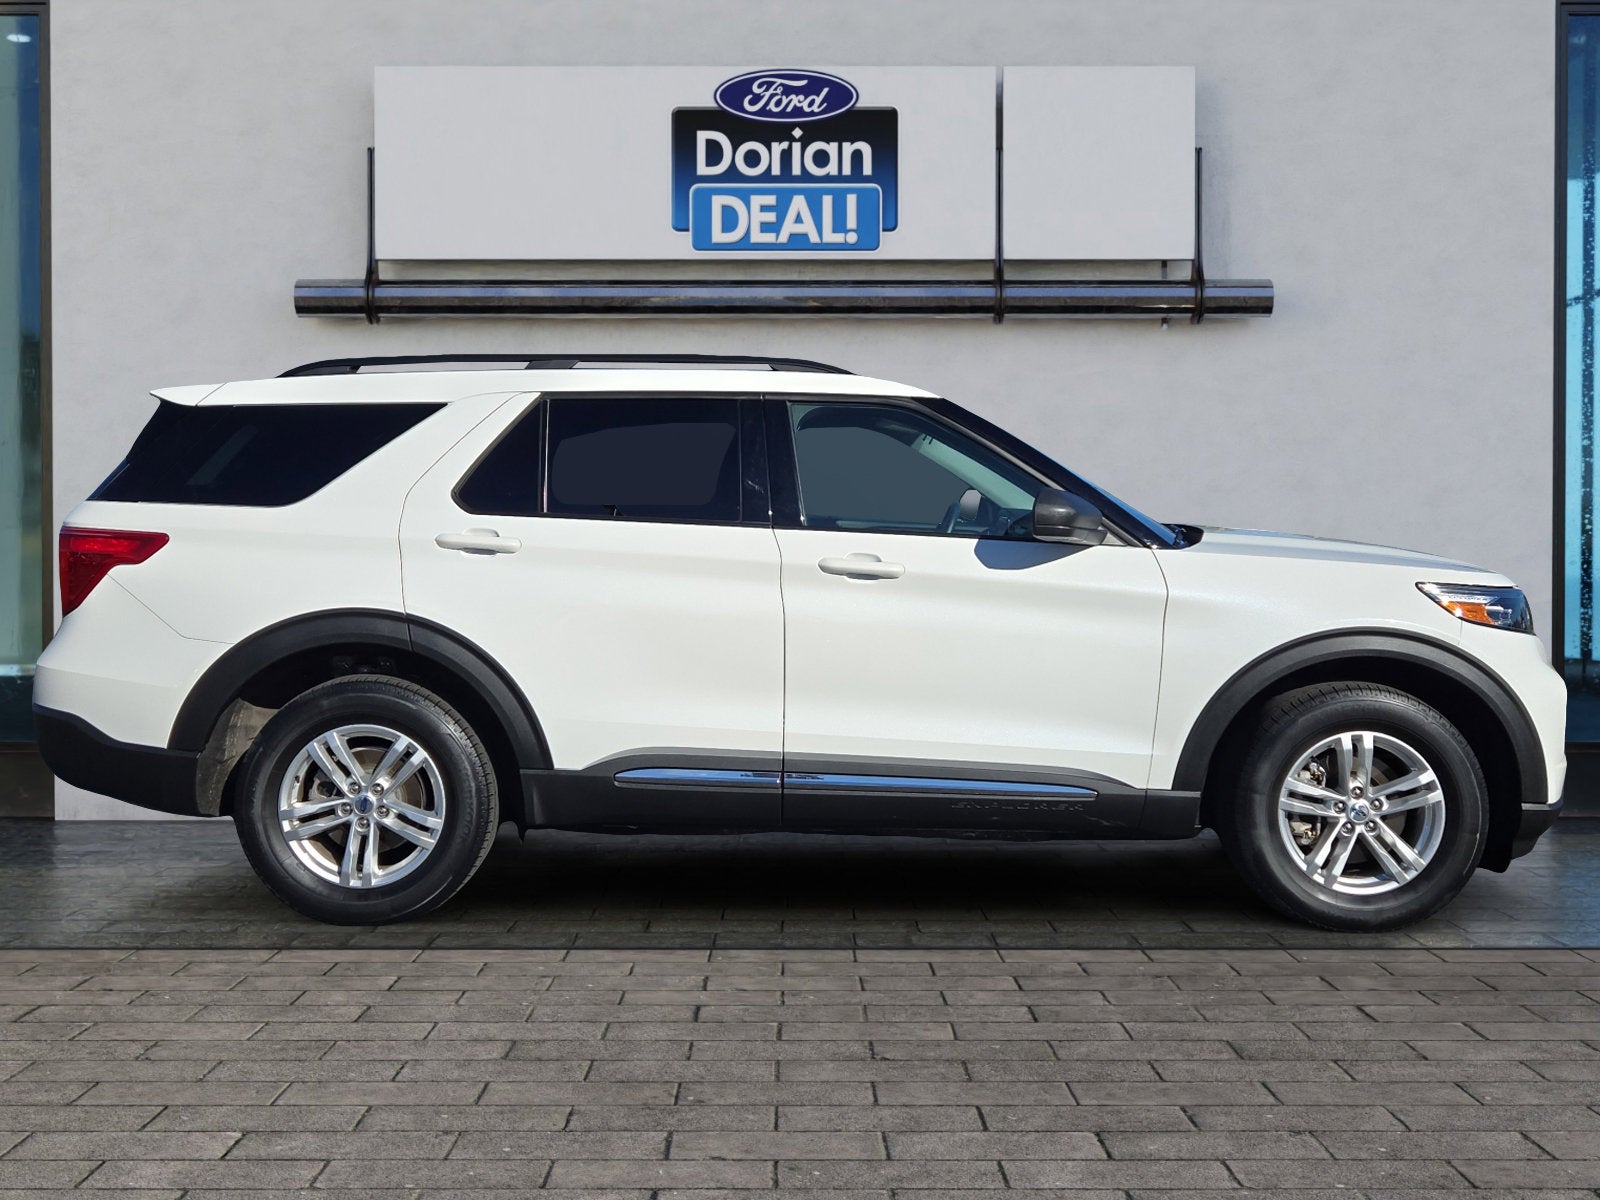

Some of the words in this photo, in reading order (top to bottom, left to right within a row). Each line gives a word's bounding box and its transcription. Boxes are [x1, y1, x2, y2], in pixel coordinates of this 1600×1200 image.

[743, 77, 830, 113] Ford
[696, 127, 873, 176] Dorian
[711, 194, 859, 245] DEAL!
